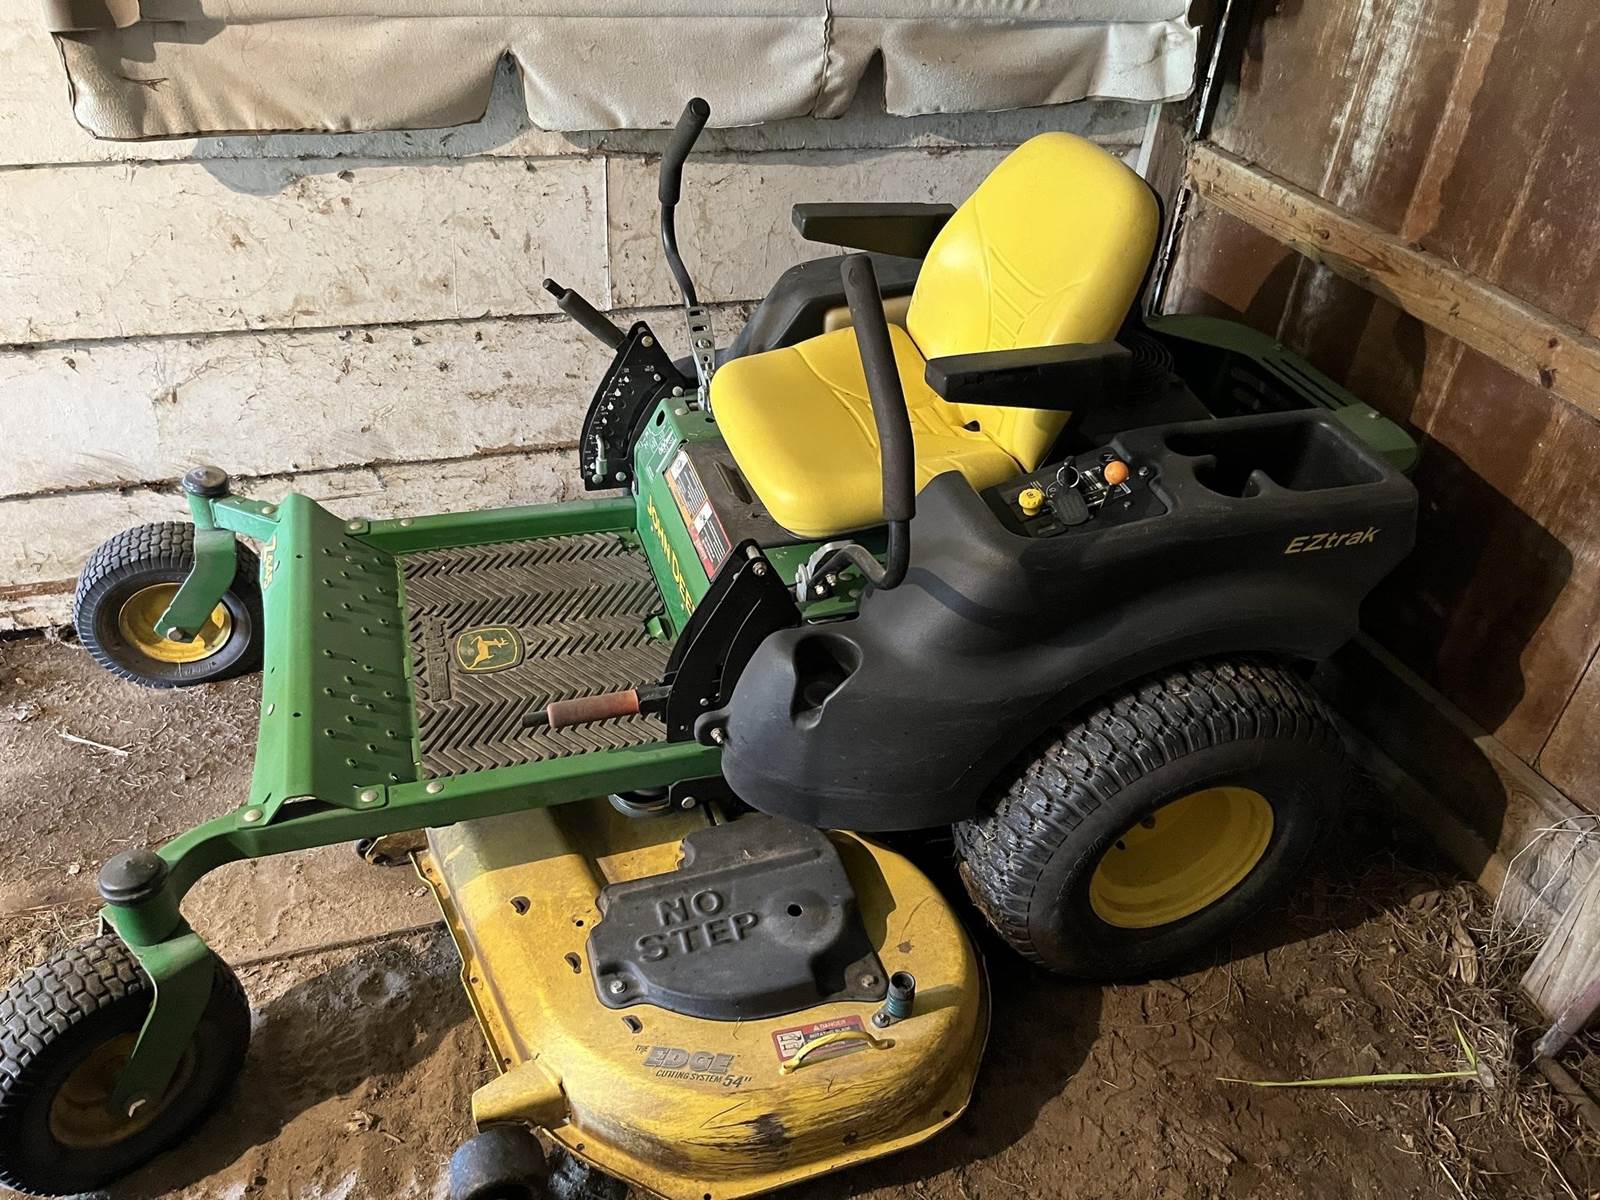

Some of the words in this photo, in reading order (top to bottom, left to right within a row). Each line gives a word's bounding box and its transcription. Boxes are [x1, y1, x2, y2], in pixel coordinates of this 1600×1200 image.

[647, 493, 672, 565] JOHN
[672, 549, 697, 618] DEE
[1284, 526, 1382, 554] EZtrak
[656, 887, 724, 927] NO
[635, 911, 759, 962] STEP
[642, 1045, 736, 1075] EDGE
[656, 1069, 690, 1080] CUTTING
[689, 1072, 722, 1084] SYSTEM
[722, 1074, 752, 1088] 54"
